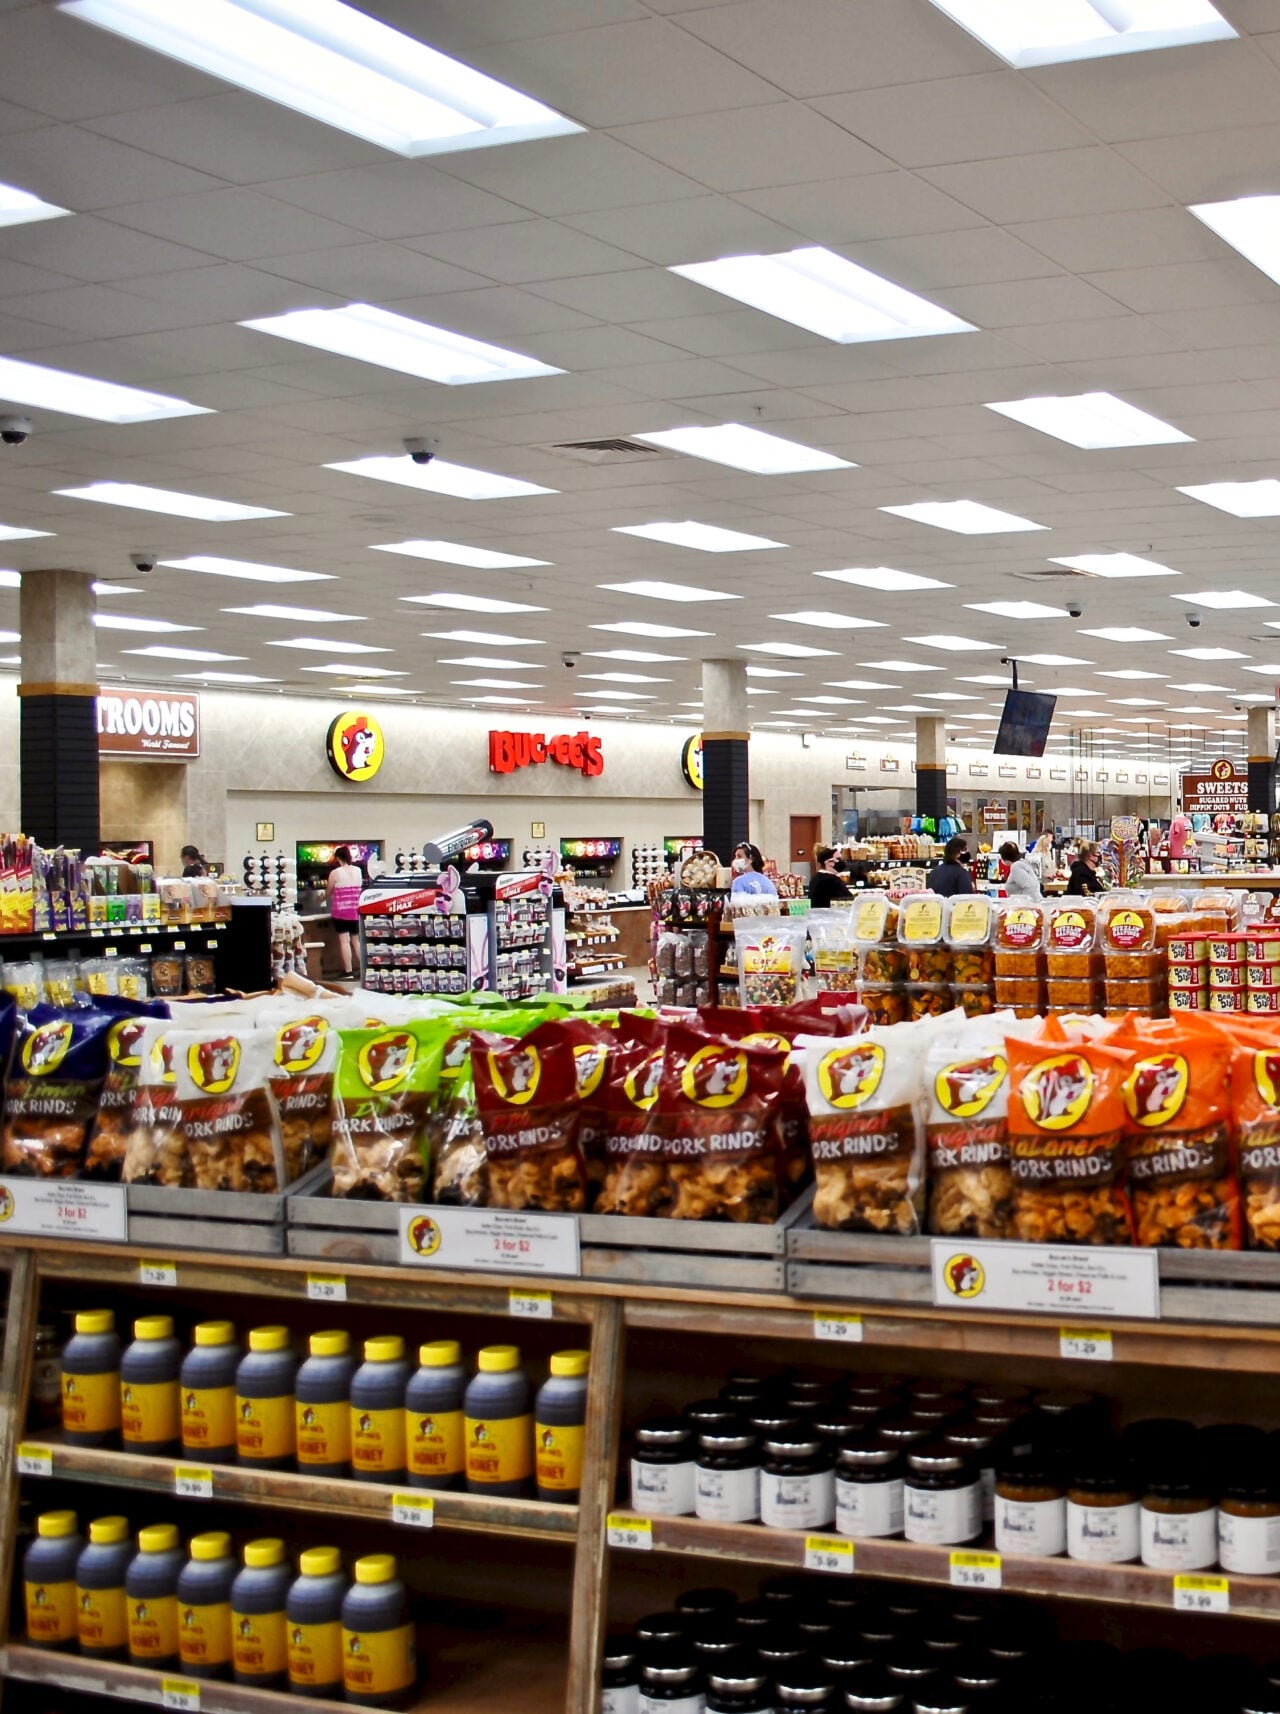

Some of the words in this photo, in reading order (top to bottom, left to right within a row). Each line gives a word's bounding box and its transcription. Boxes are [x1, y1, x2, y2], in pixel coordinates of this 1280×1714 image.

[1197, 782, 1248, 794] SWEETS
[30, 1099, 76, 1115] RINDS
[100, 1091, 126, 1107] ORK
[286, 1093, 329, 1110] RINDS
[184, 1122, 214, 1138] ORK
[486, 1135, 517, 1152] ORK
[663, 1137, 706, 1154] PORK
[710, 1129, 766, 1151] RINDS
[812, 1140, 841, 1160] ORK
[844, 1132, 898, 1155] RINDS
[1056, 1151, 1112, 1177] RINDS
[1152, 1145, 1214, 1174] RINDS
[64, 1206, 75, 1218] for
[78, 1207, 87, 1219] $2
[502, 1239, 516, 1251] for
[519, 1240, 530, 1253] $2
[1048, 1279, 1055, 1292] 2
[1058, 1279, 1075, 1293] for
[1078, 1280, 1092, 1295] $2
